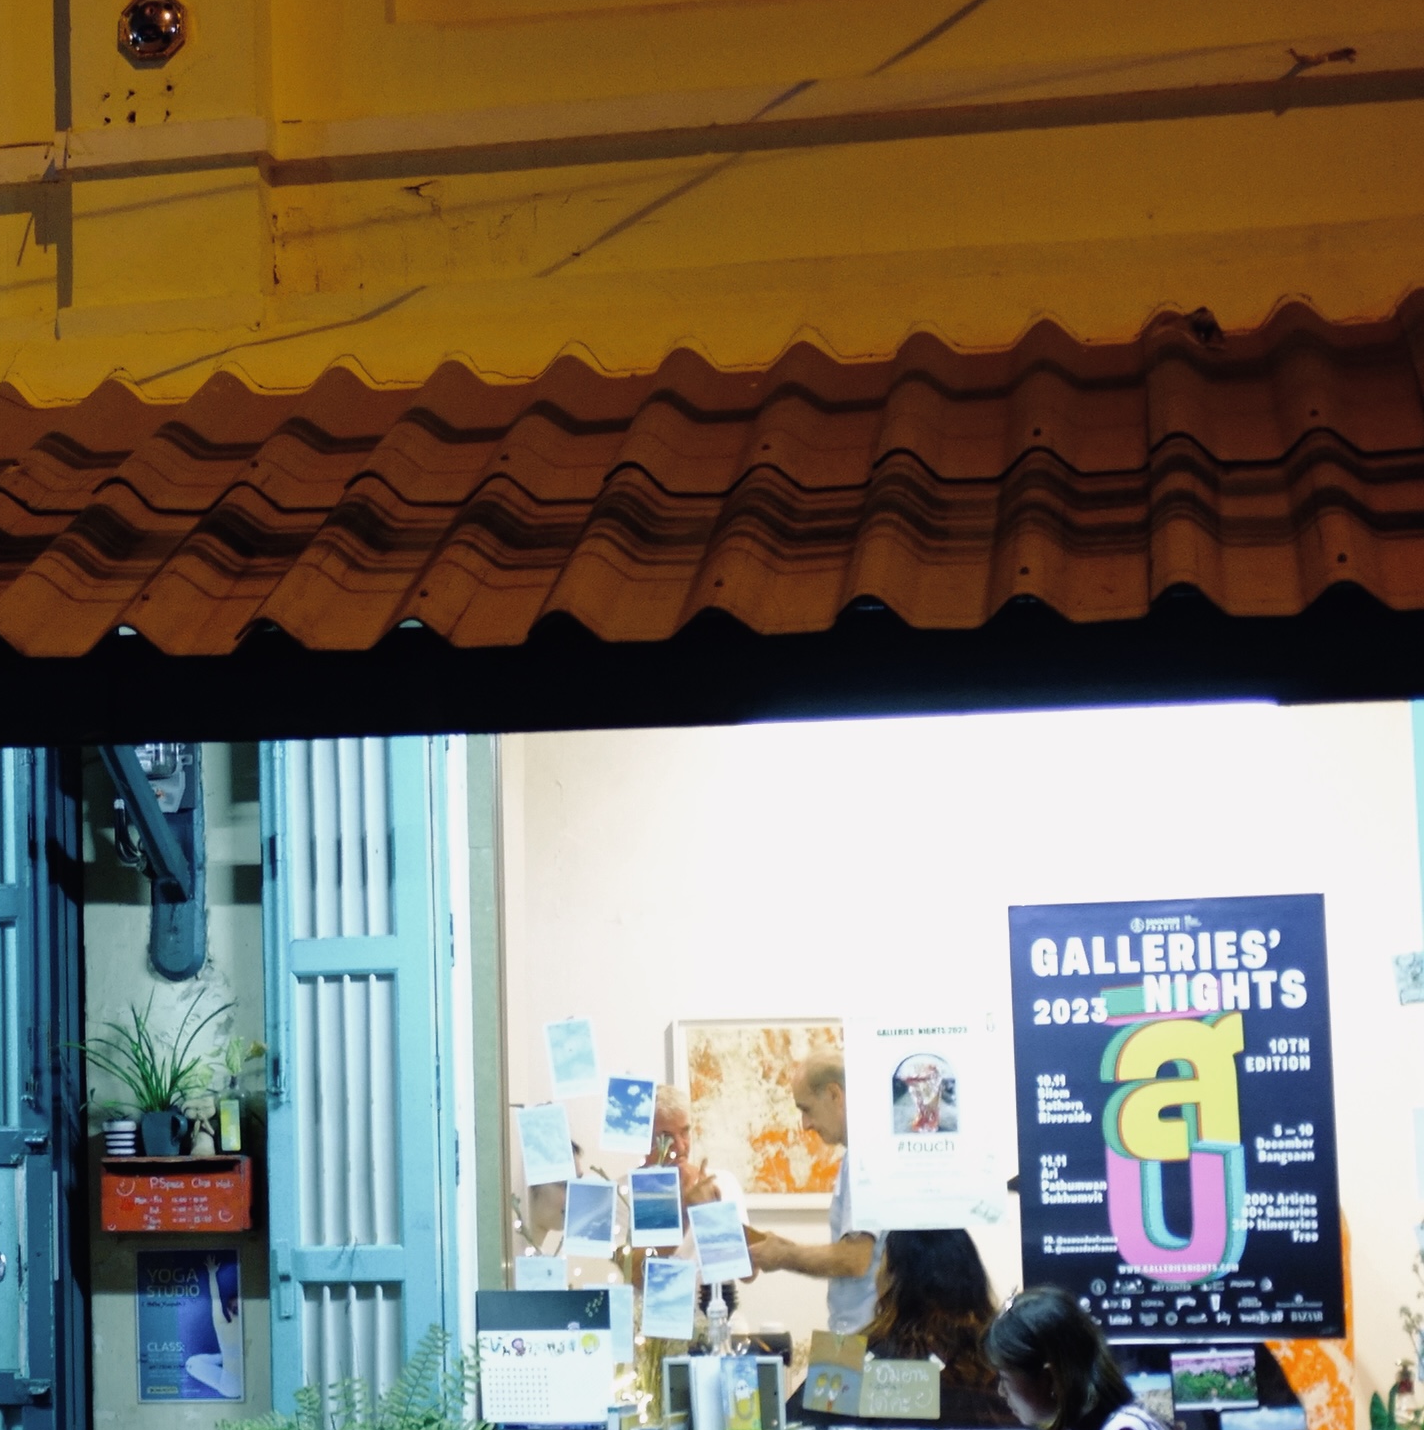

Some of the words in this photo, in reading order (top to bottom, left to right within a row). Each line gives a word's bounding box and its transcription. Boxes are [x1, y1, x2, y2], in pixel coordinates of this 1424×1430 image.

[1142, 968, 1308, 1014] NIGHTS
[1033, 997, 1109, 1026] 2023
[948, 1026, 968, 1034] 2023
[1268, 1037, 1311, 1055] 10TH
[1244, 1055, 1312, 1073] EDITION
[1038, 1112, 1093, 1124] Riverside
[897, 1139, 955, 1153] #touch
[1255, 1137, 1315, 1150] December
[1041, 1181, 1108, 1192] Pathumwan
[1041, 1191, 1104, 1204] Sukhumvit
[1265, 1204, 1318, 1218] Galleries
[1256, 1217, 1319, 1231] Itineraries
[147, 1269, 199, 1283] YOGA
[146, 1284, 200, 1297] STUDIO
